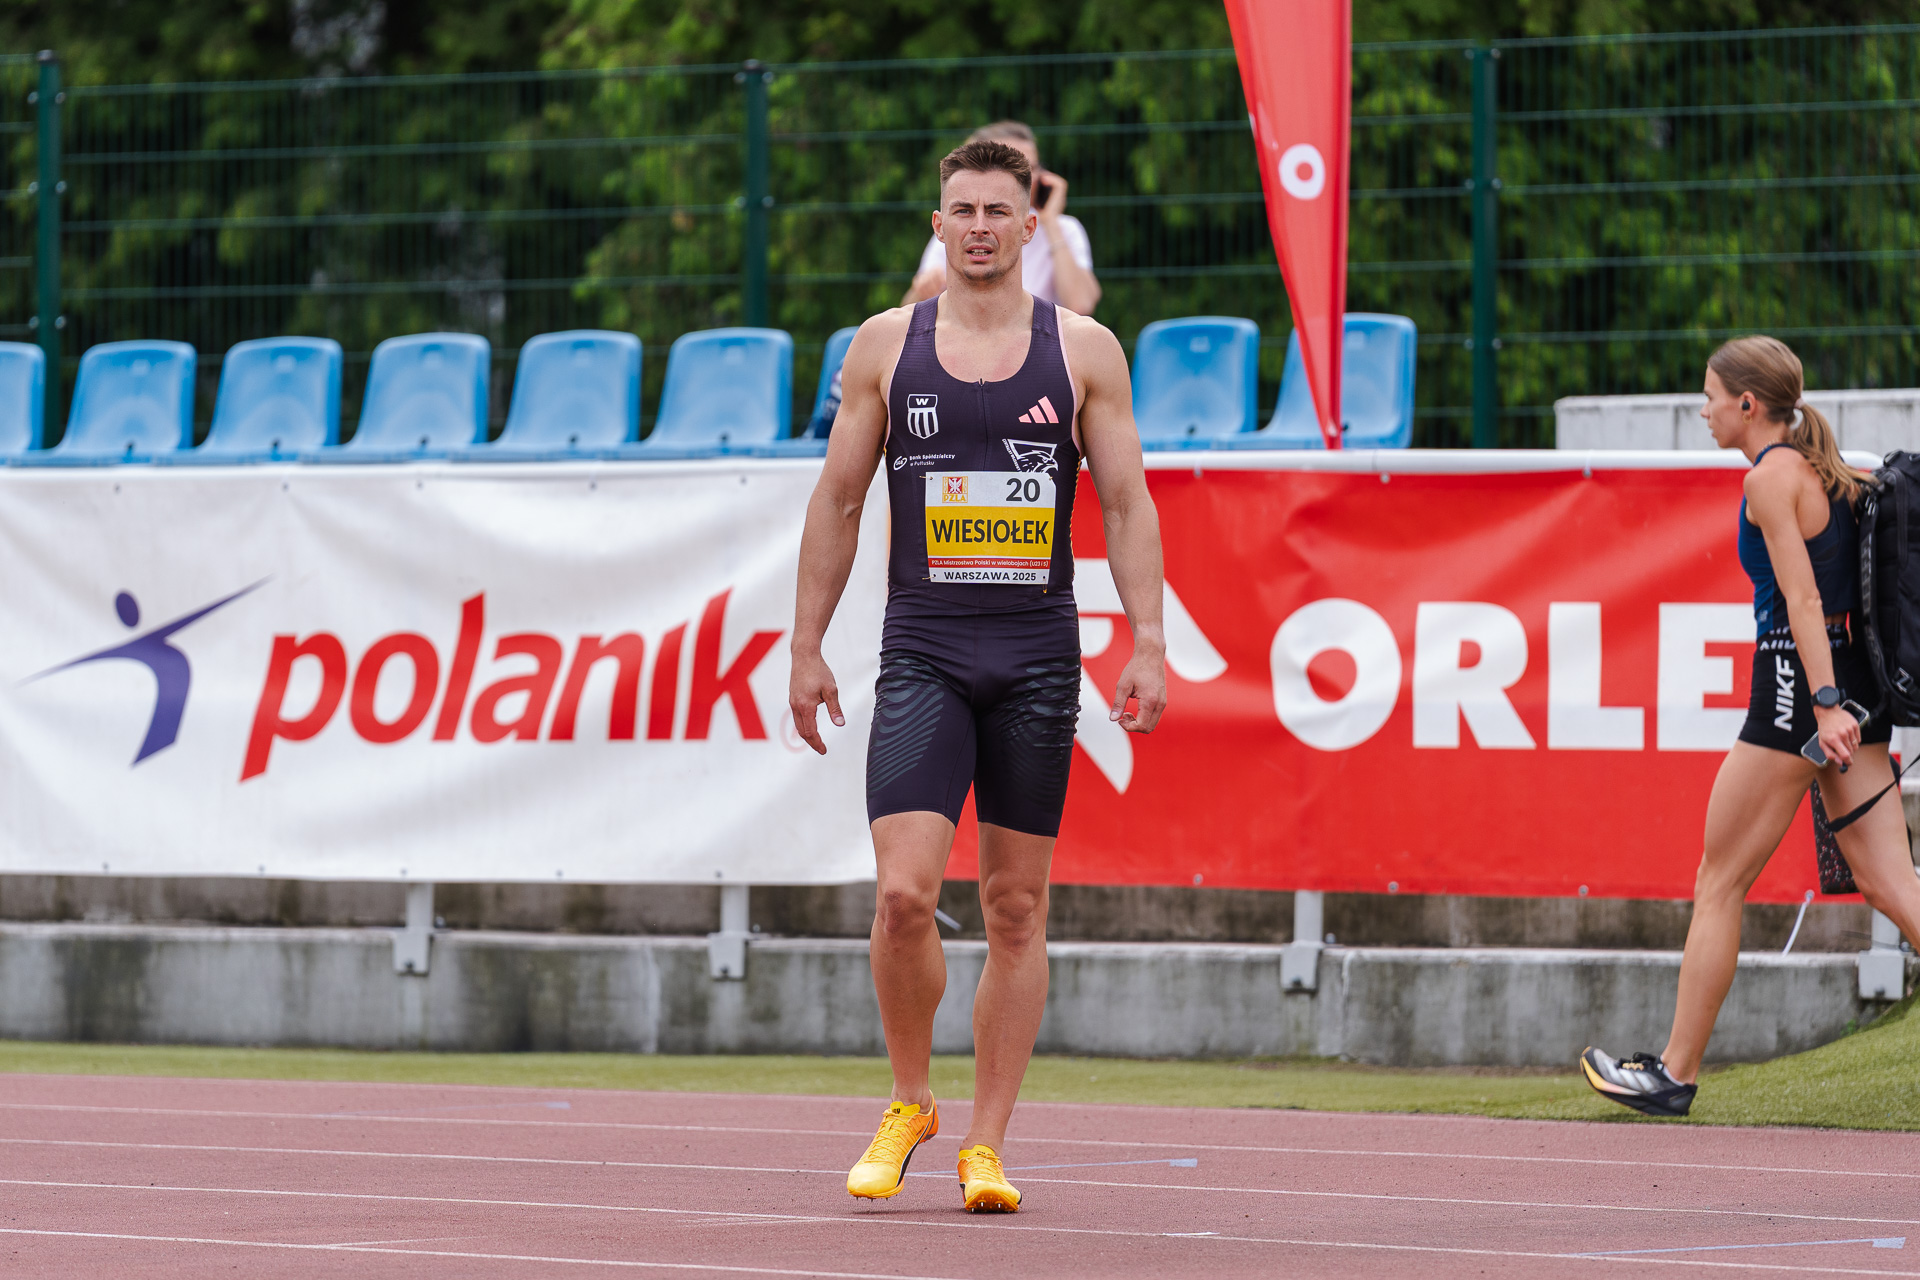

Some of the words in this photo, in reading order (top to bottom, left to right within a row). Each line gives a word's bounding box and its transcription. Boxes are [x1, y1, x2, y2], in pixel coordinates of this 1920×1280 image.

[915, 397, 929, 406] W
[943, 494, 966, 502] PZLA
[1005, 478, 1040, 502] 20
[932, 519, 1049, 544] WIESIOŁEK
[944, 571, 1010, 581] WARSZAWA
[1012, 572, 1036, 581] 2025
[240, 587, 786, 783] polanik
[1270, 597, 1757, 752] ORLE
